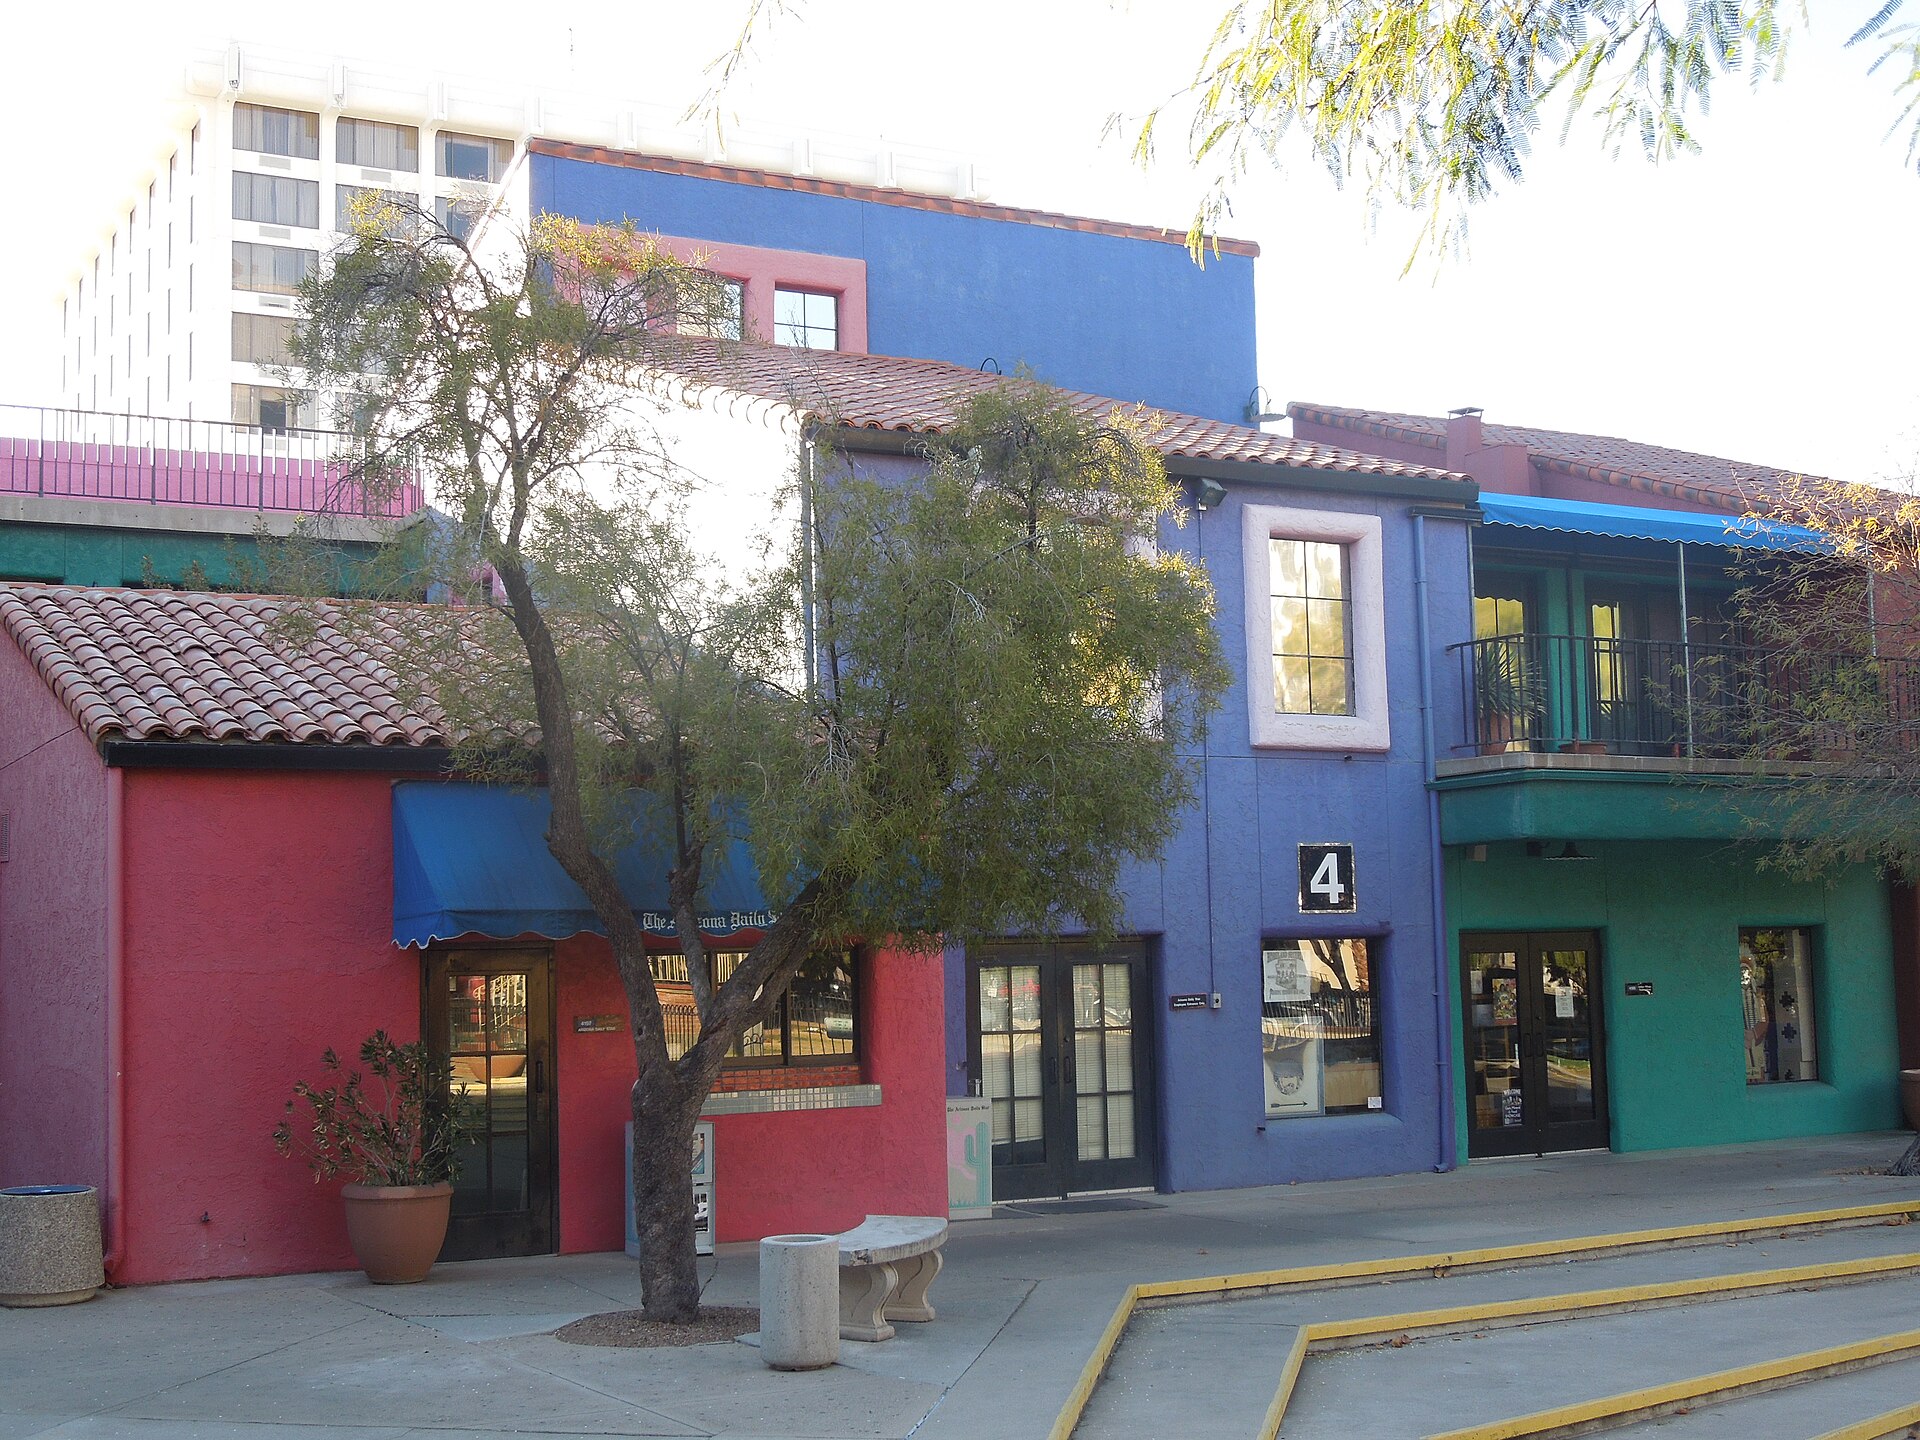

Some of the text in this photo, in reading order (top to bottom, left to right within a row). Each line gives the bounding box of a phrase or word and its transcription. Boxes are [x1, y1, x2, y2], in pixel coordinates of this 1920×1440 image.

[1310, 852, 1345, 904] 4
[642, 912, 667, 931] The
[730, 909, 768, 931] Daily
